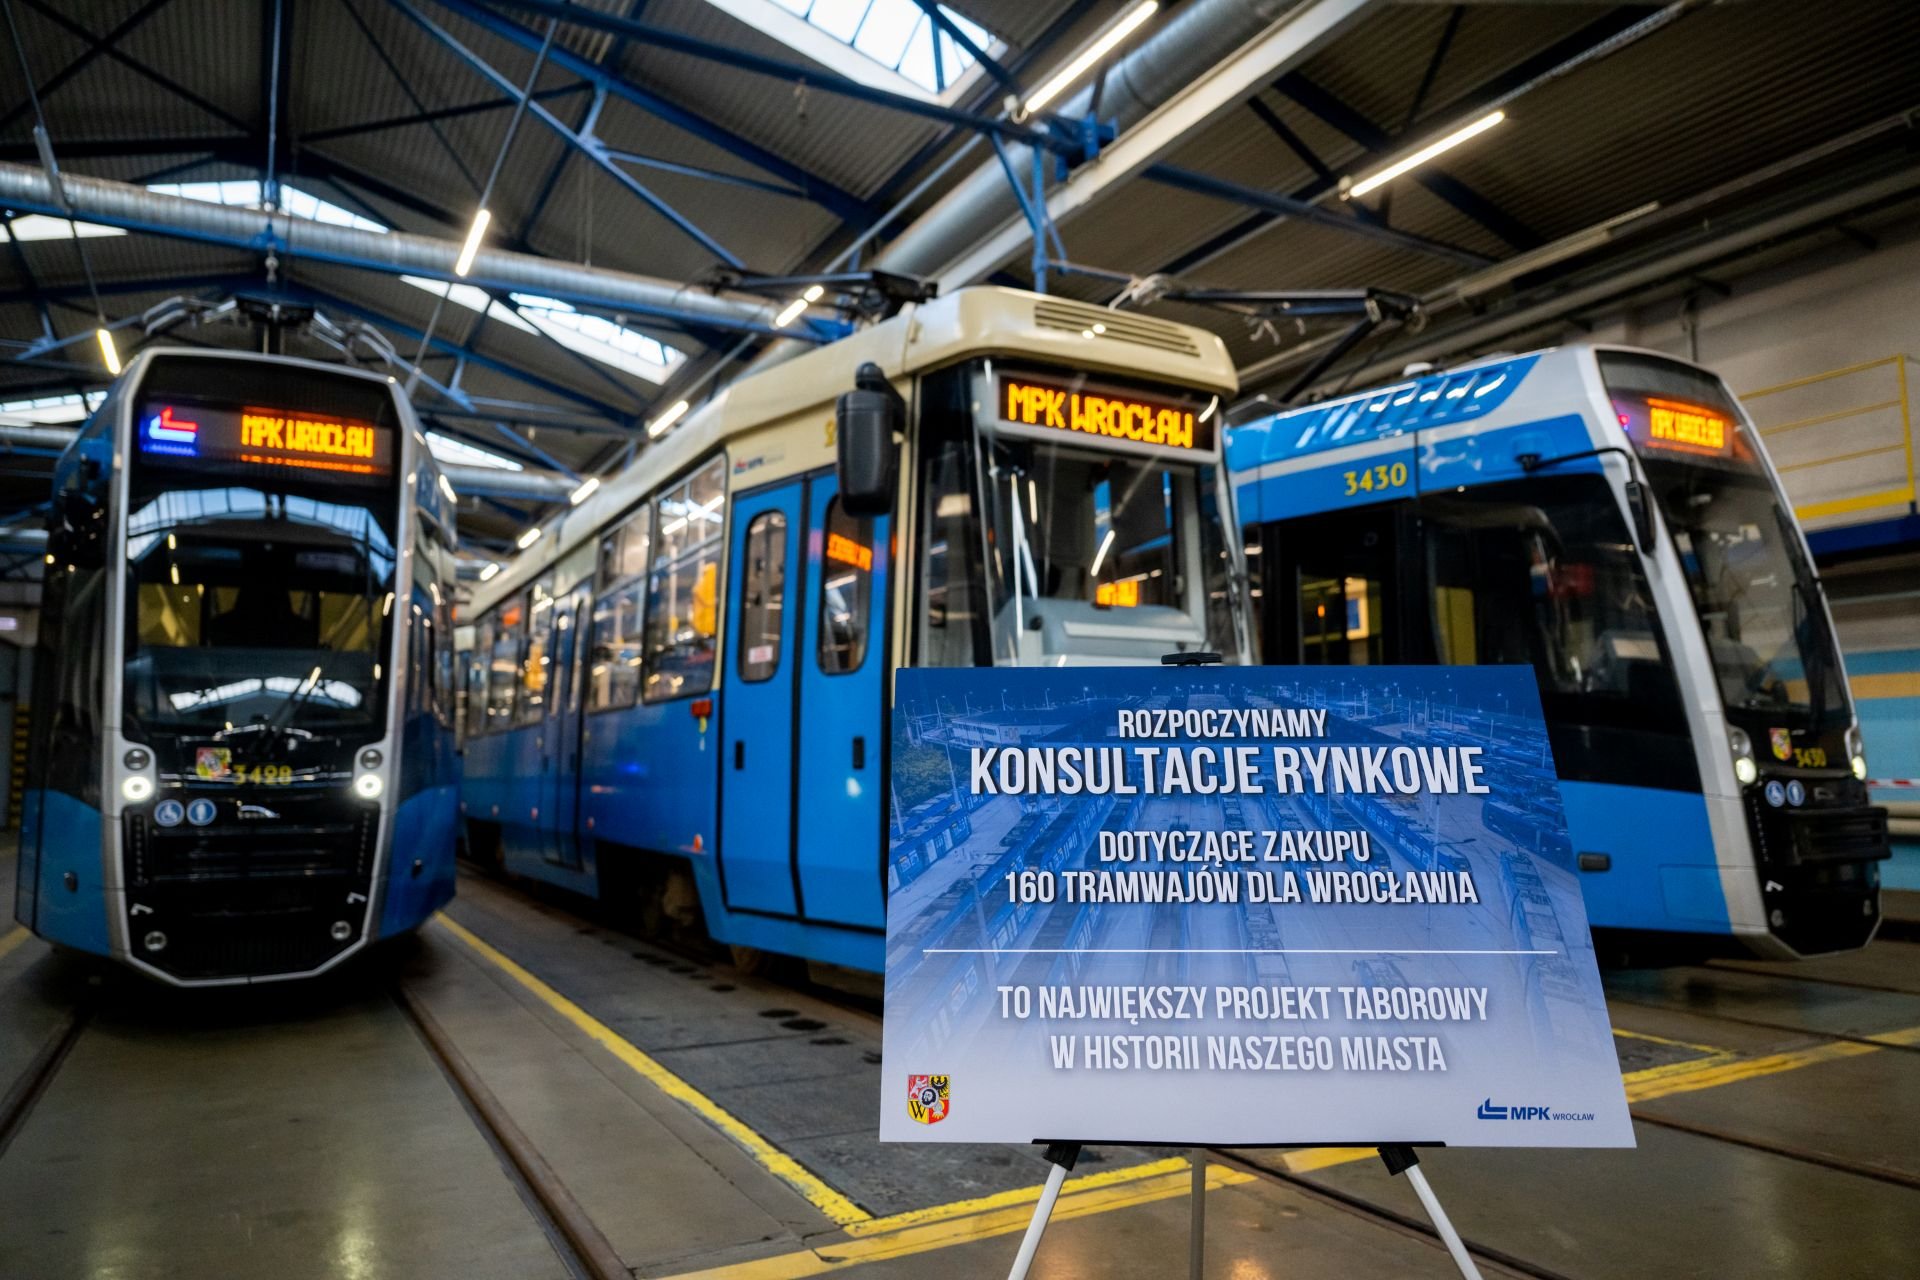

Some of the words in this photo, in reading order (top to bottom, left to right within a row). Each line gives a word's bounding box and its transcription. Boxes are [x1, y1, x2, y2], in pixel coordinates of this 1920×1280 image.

[1007, 383, 1066, 429] MPK
[1070, 394, 1193, 449] WROCŁAW
[240, 414, 285, 450] MPK
[285, 419, 375, 459] WROCŁAW
[1343, 461, 1408, 497] 3430
[1117, 708, 1327, 739] ROZPOCZYNAMY
[970, 746, 1264, 795] KONSULTACJE
[1273, 746, 1491, 795] RYNKOWE
[1099, 830, 1256, 868] DOTYCZĄCE
[1262, 830, 1370, 863] ZAKUPU
[1005, 871, 1055, 904] 160
[1061, 865, 1239, 904] TRAMWAJÓW
[1246, 871, 1302, 904] DLA
[1306, 871, 1479, 904] WROCŁAWIA
[997, 985, 1031, 1019] TO
[1039, 985, 1207, 1026] NAJWIĘKSZY
[1215, 986, 1331, 1020] PROJEKT
[1337, 987, 1488, 1021] TABOROWY
[1050, 1035, 1076, 1069] W
[1084, 1035, 1200, 1070] HISTORII
[1207, 1036, 1334, 1071] NASZEGO
[1340, 1036, 1447, 1072] MIASTA
[1510, 1106, 1551, 1121] MPK
[1552, 1112, 1595, 1121] WROCŁAW
